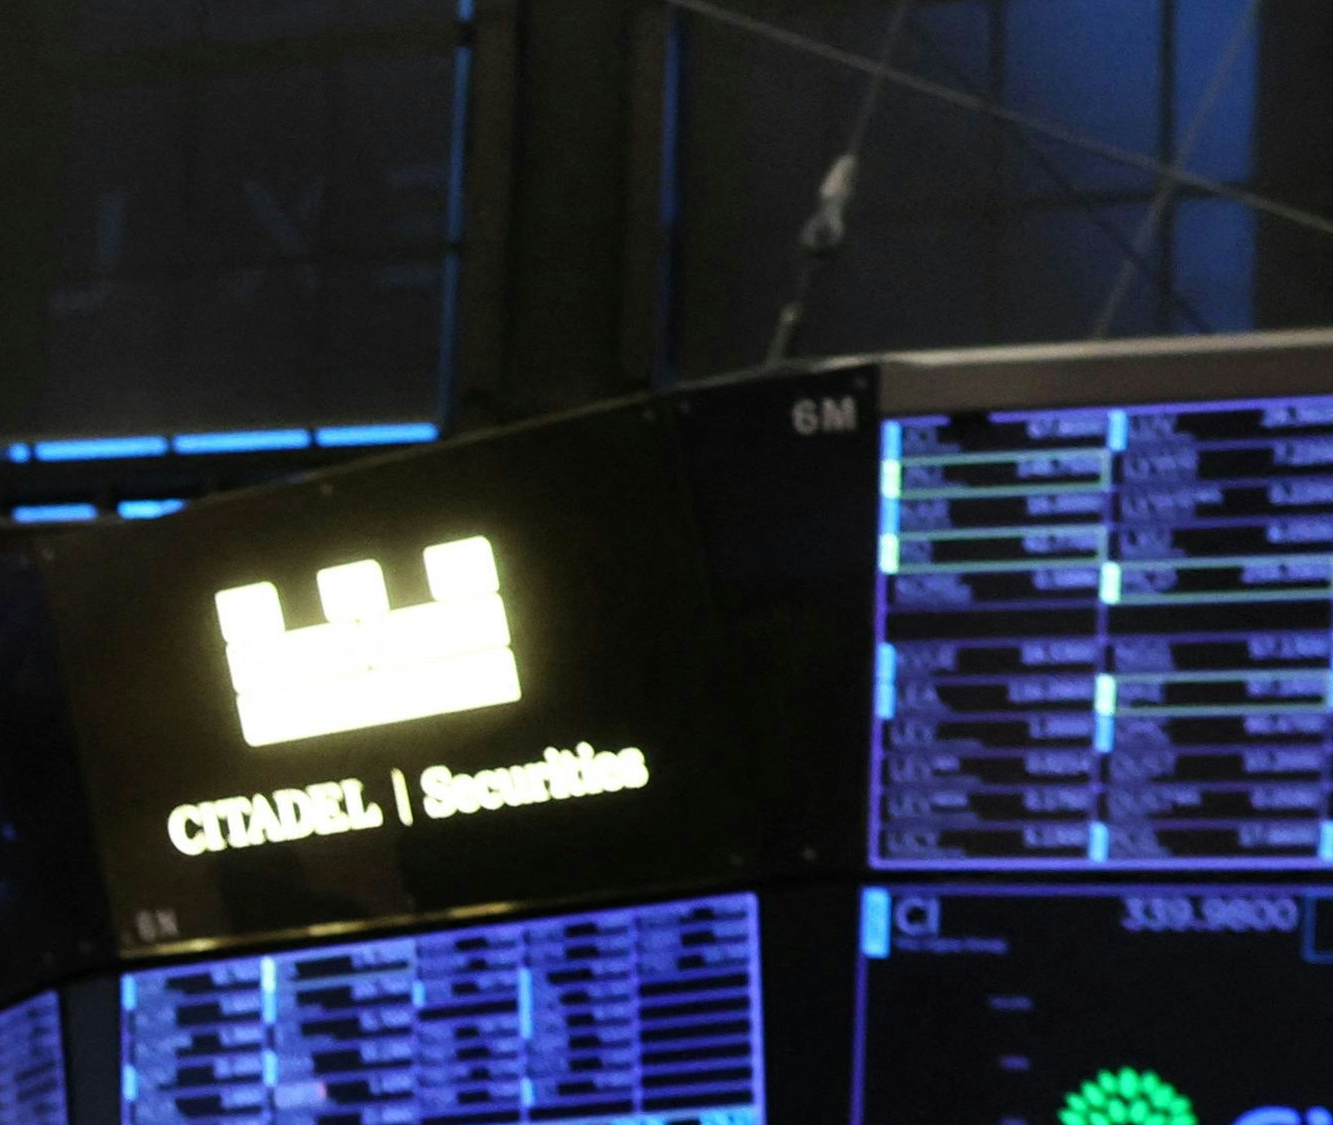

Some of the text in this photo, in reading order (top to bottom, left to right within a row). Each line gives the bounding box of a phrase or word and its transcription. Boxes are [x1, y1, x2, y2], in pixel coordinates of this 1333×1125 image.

[792, 396, 856, 436] 6M
[168, 741, 649, 856] CITADEL Securities
